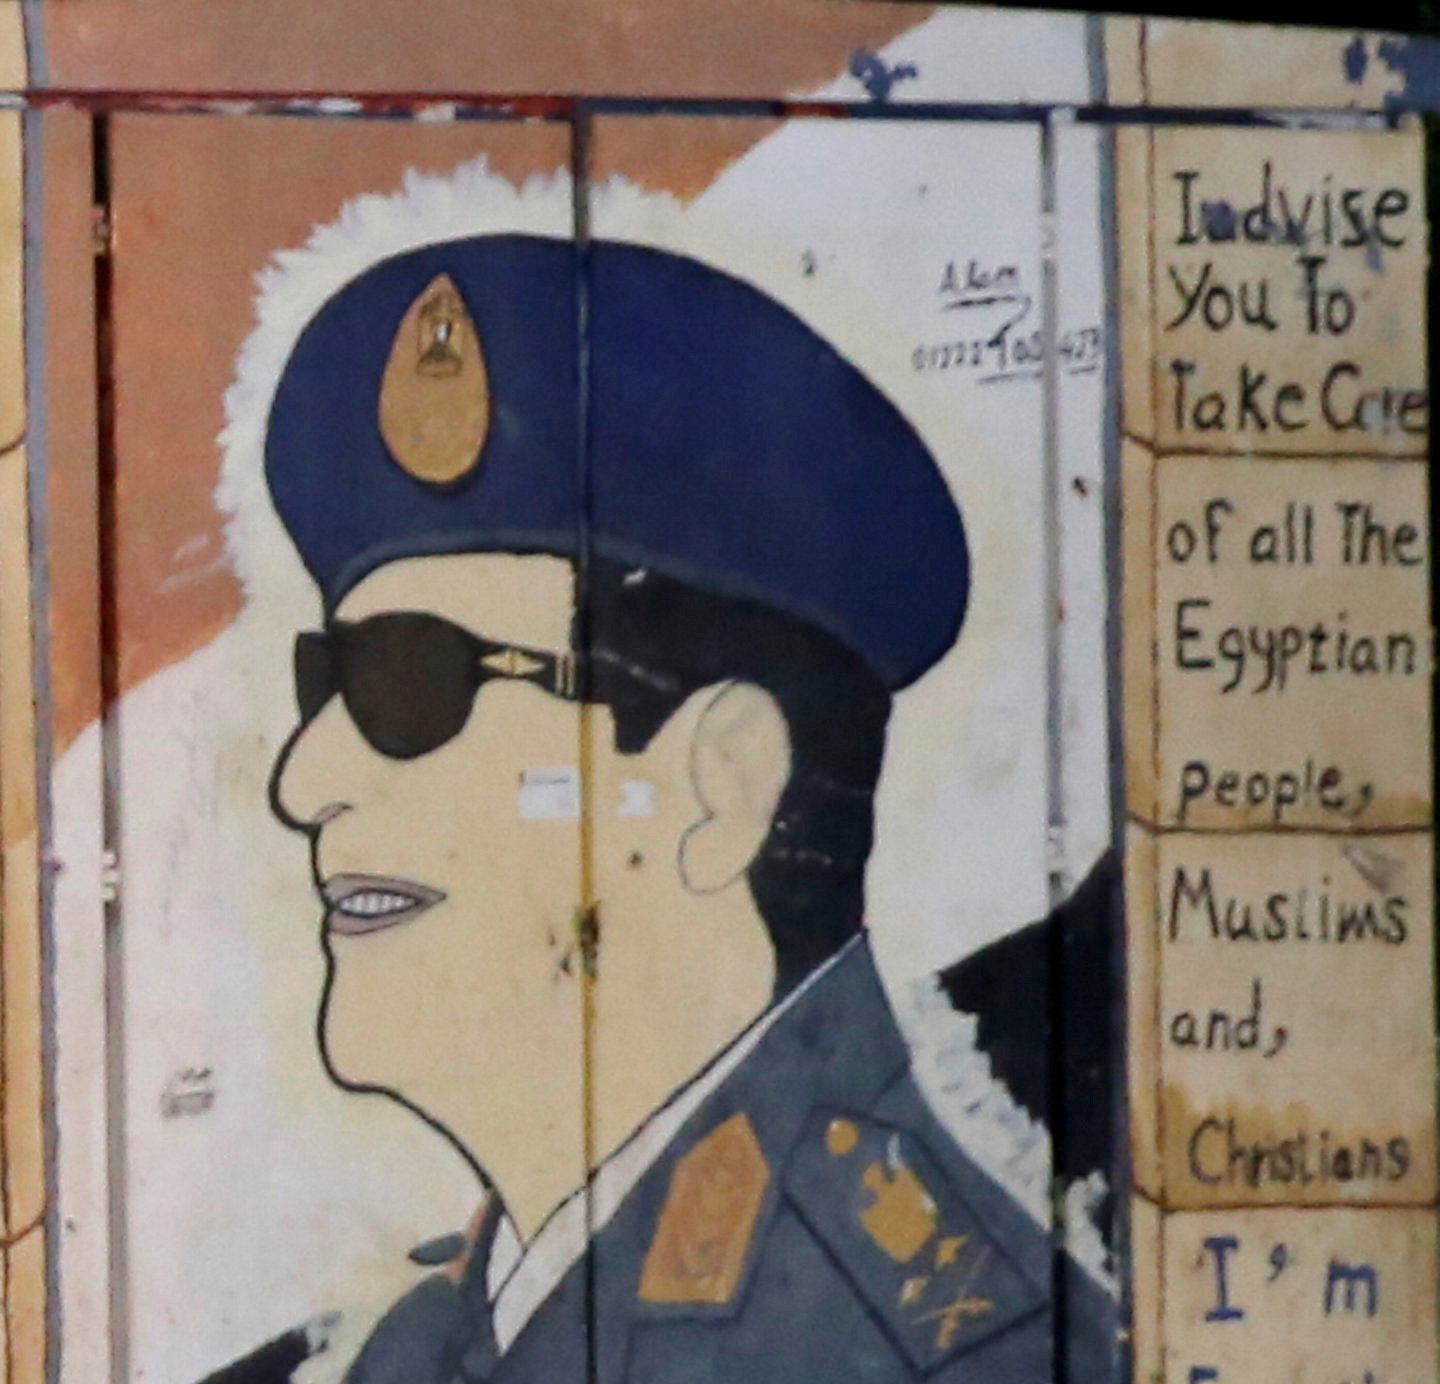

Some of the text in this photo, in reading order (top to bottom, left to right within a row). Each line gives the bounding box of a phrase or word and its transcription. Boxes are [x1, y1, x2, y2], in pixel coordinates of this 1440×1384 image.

[1164, 254, 1356, 336] You To
[1166, 497, 1423, 566] of all The
[1174, 597, 1418, 695] Egyptian
[1168, 866, 1408, 947] Muslims
